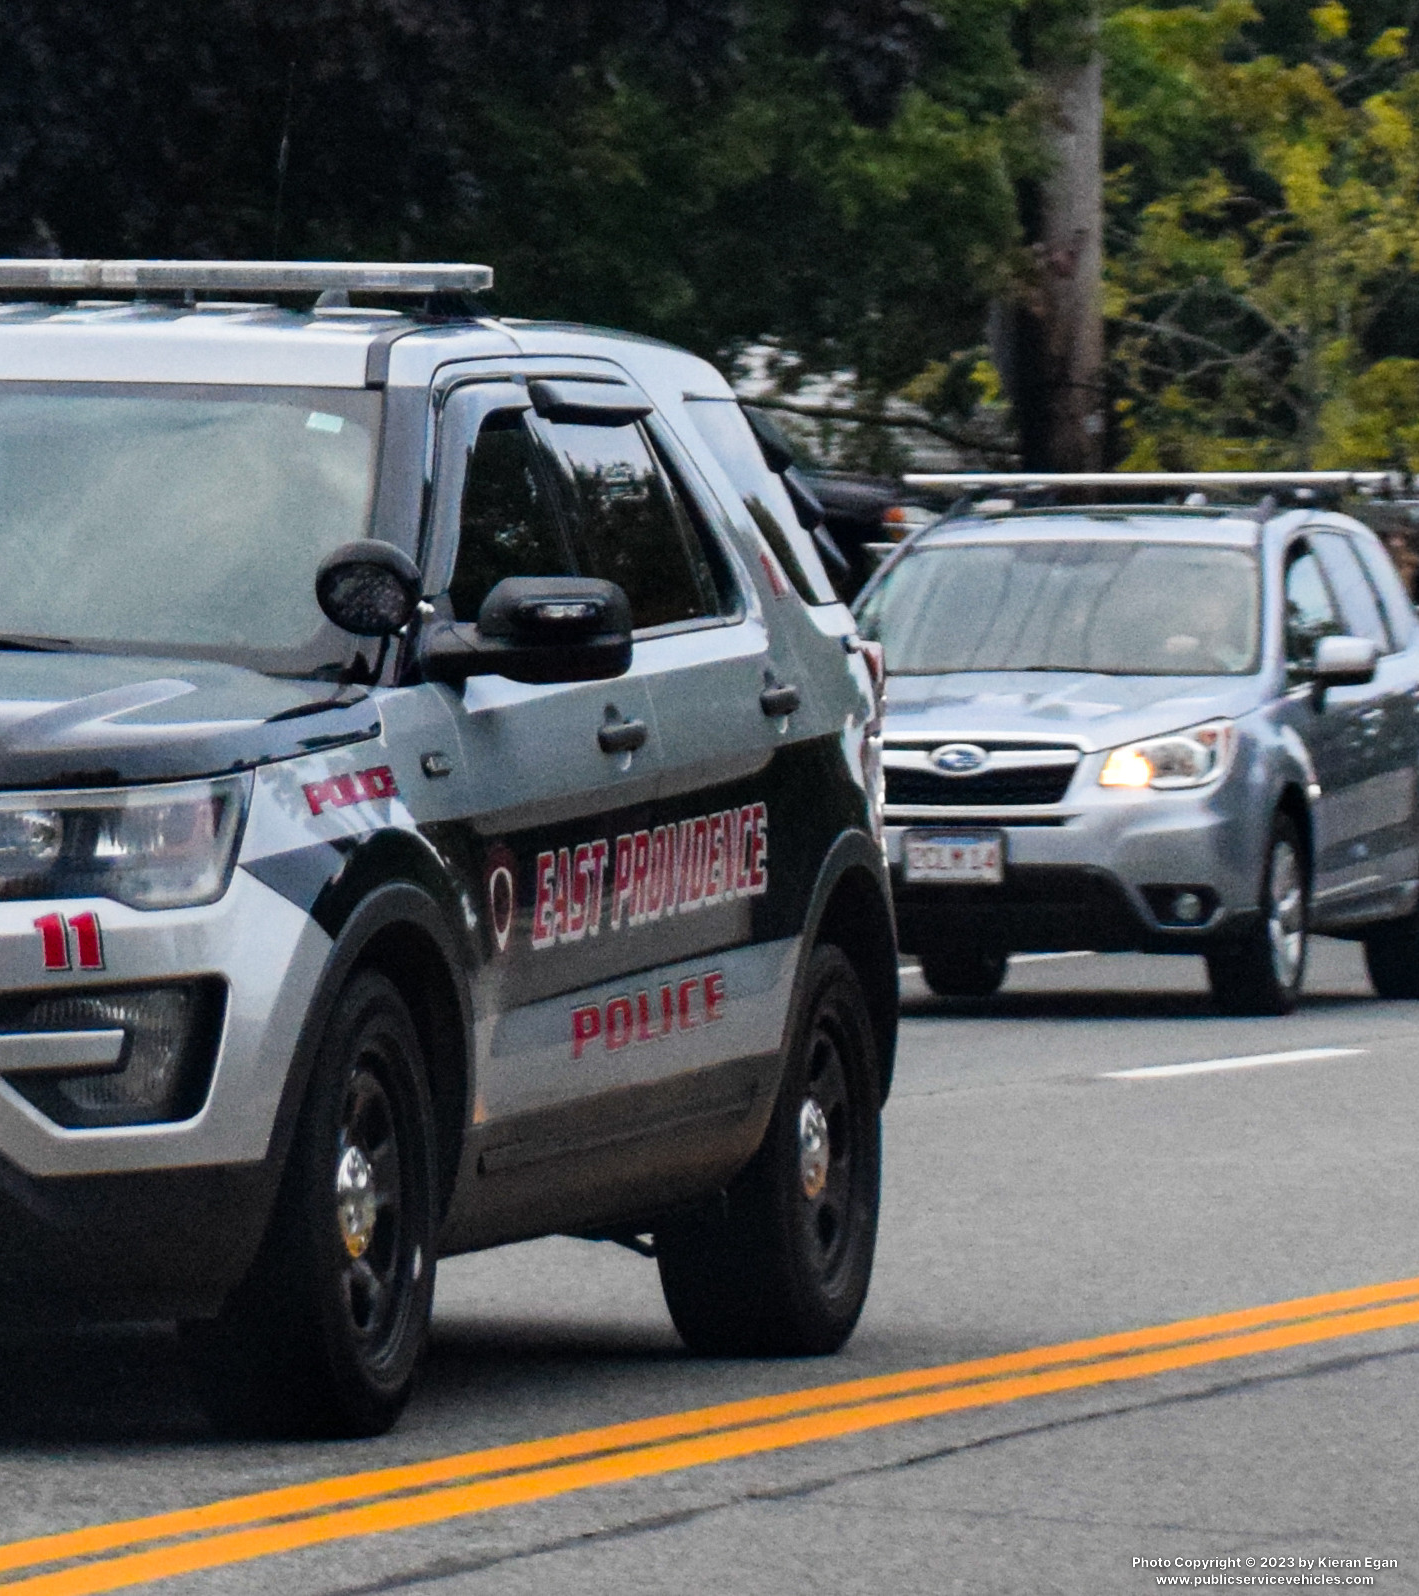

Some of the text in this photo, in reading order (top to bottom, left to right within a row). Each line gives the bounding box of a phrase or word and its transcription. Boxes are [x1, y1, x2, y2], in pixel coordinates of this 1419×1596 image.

[301, 765, 400, 816] POLICE
[532, 801, 768, 951] EAST PROVIDENCE
[33, 910, 106, 971] 11
[571, 970, 725, 1060] POLICE
